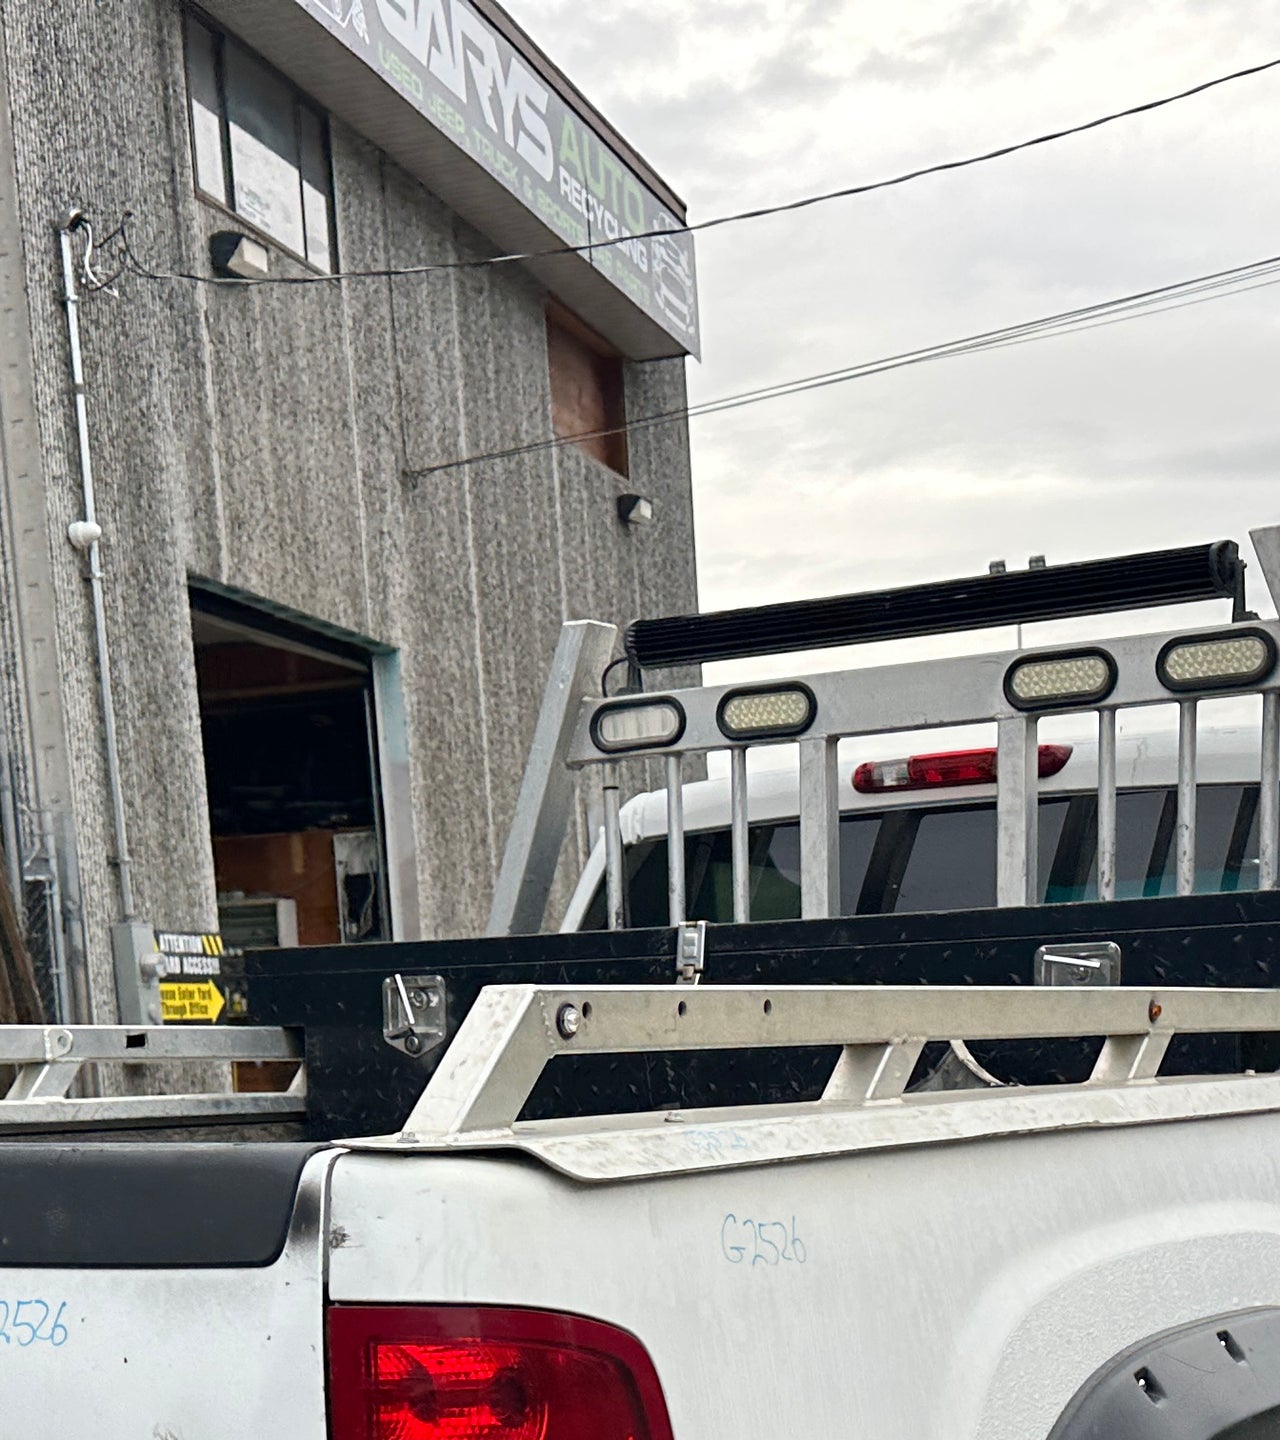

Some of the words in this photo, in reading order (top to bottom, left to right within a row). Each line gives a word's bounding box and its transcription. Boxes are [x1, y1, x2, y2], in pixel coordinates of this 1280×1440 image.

[377, 41, 423, 102] USED
[558, 113, 646, 236] AUTO
[559, 165, 649, 273] RECYCLING
[721, 1213, 808, 1267] G2526
